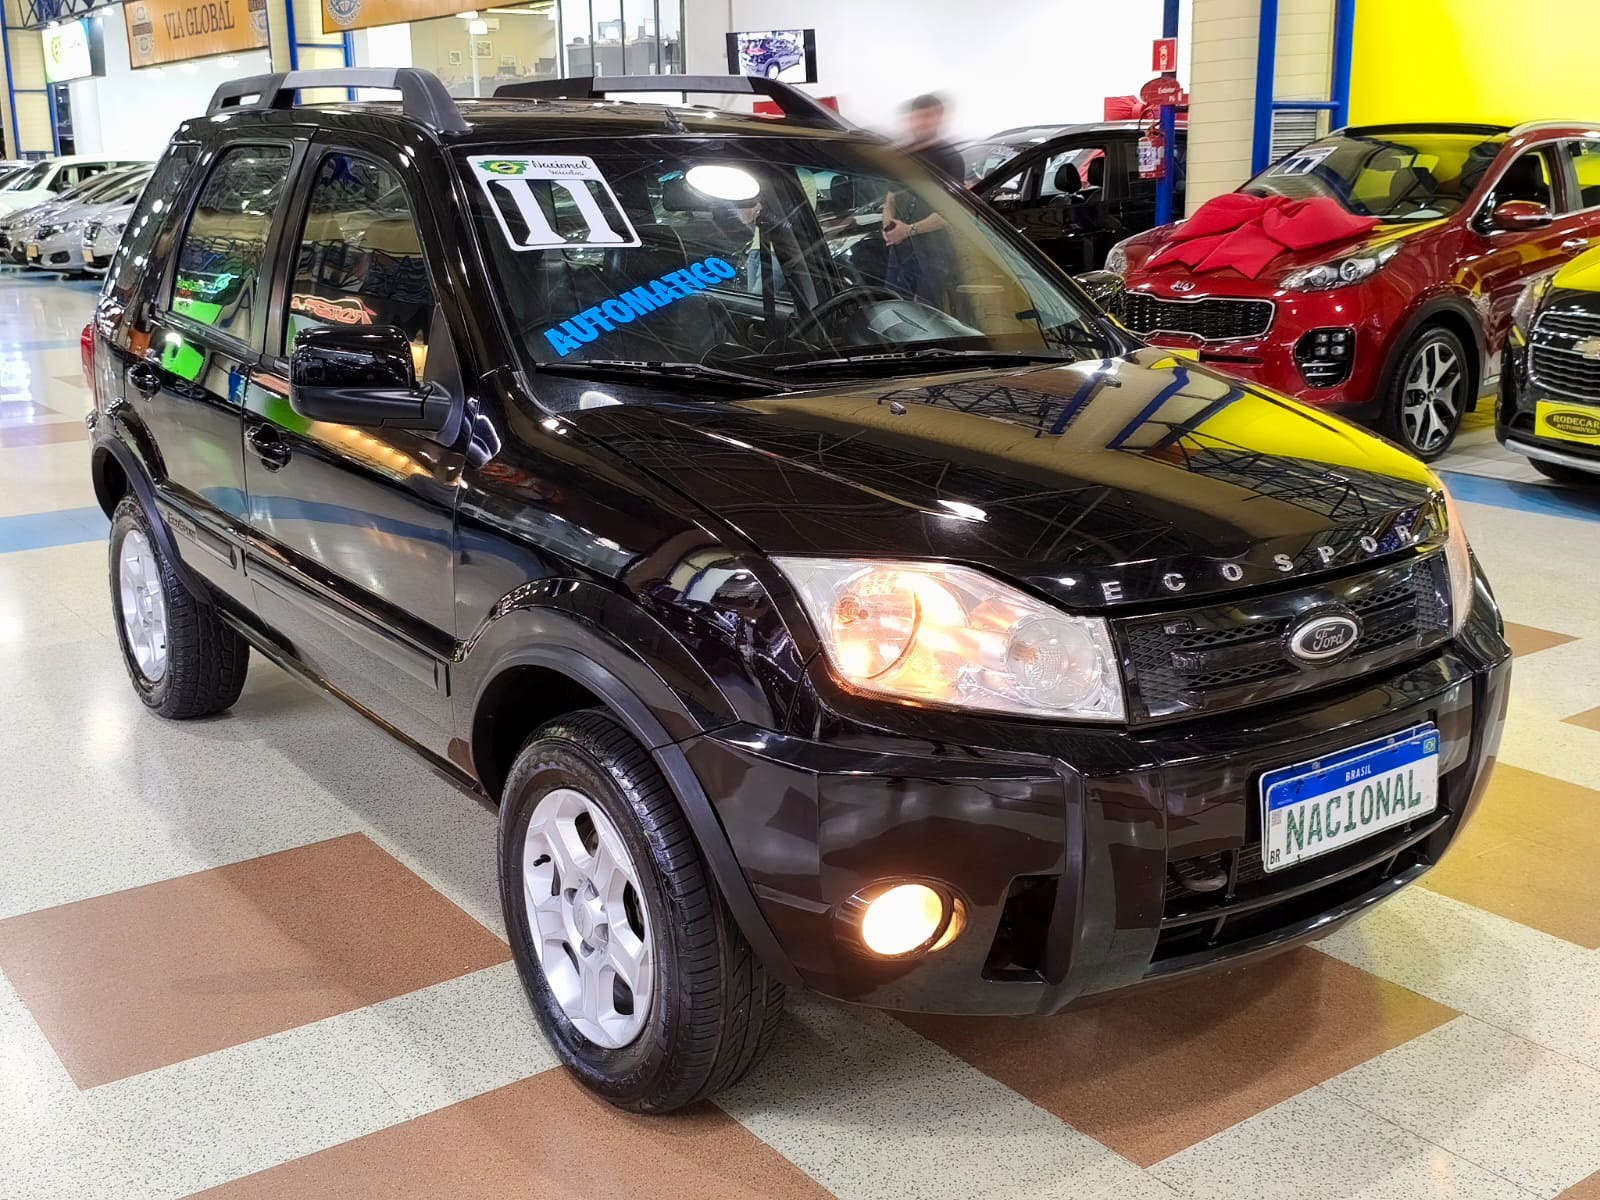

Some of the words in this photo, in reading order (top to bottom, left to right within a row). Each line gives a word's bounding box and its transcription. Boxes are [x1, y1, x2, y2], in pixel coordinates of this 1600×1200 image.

[163, 12, 186, 41] VIA
[185, 0, 235, 36] GLOBAL
[531, 159, 592, 170] Nacional
[495, 180, 625, 245] 11
[543, 257, 737, 358] AUTOMATICO
[1552, 414, 1600, 430] RODECAR
[1312, 626, 1345, 651] Ford
[1345, 764, 1372, 782] BRASIL
[1286, 769, 1422, 855] NACIONAL
[1270, 848, 1281, 865] BR
